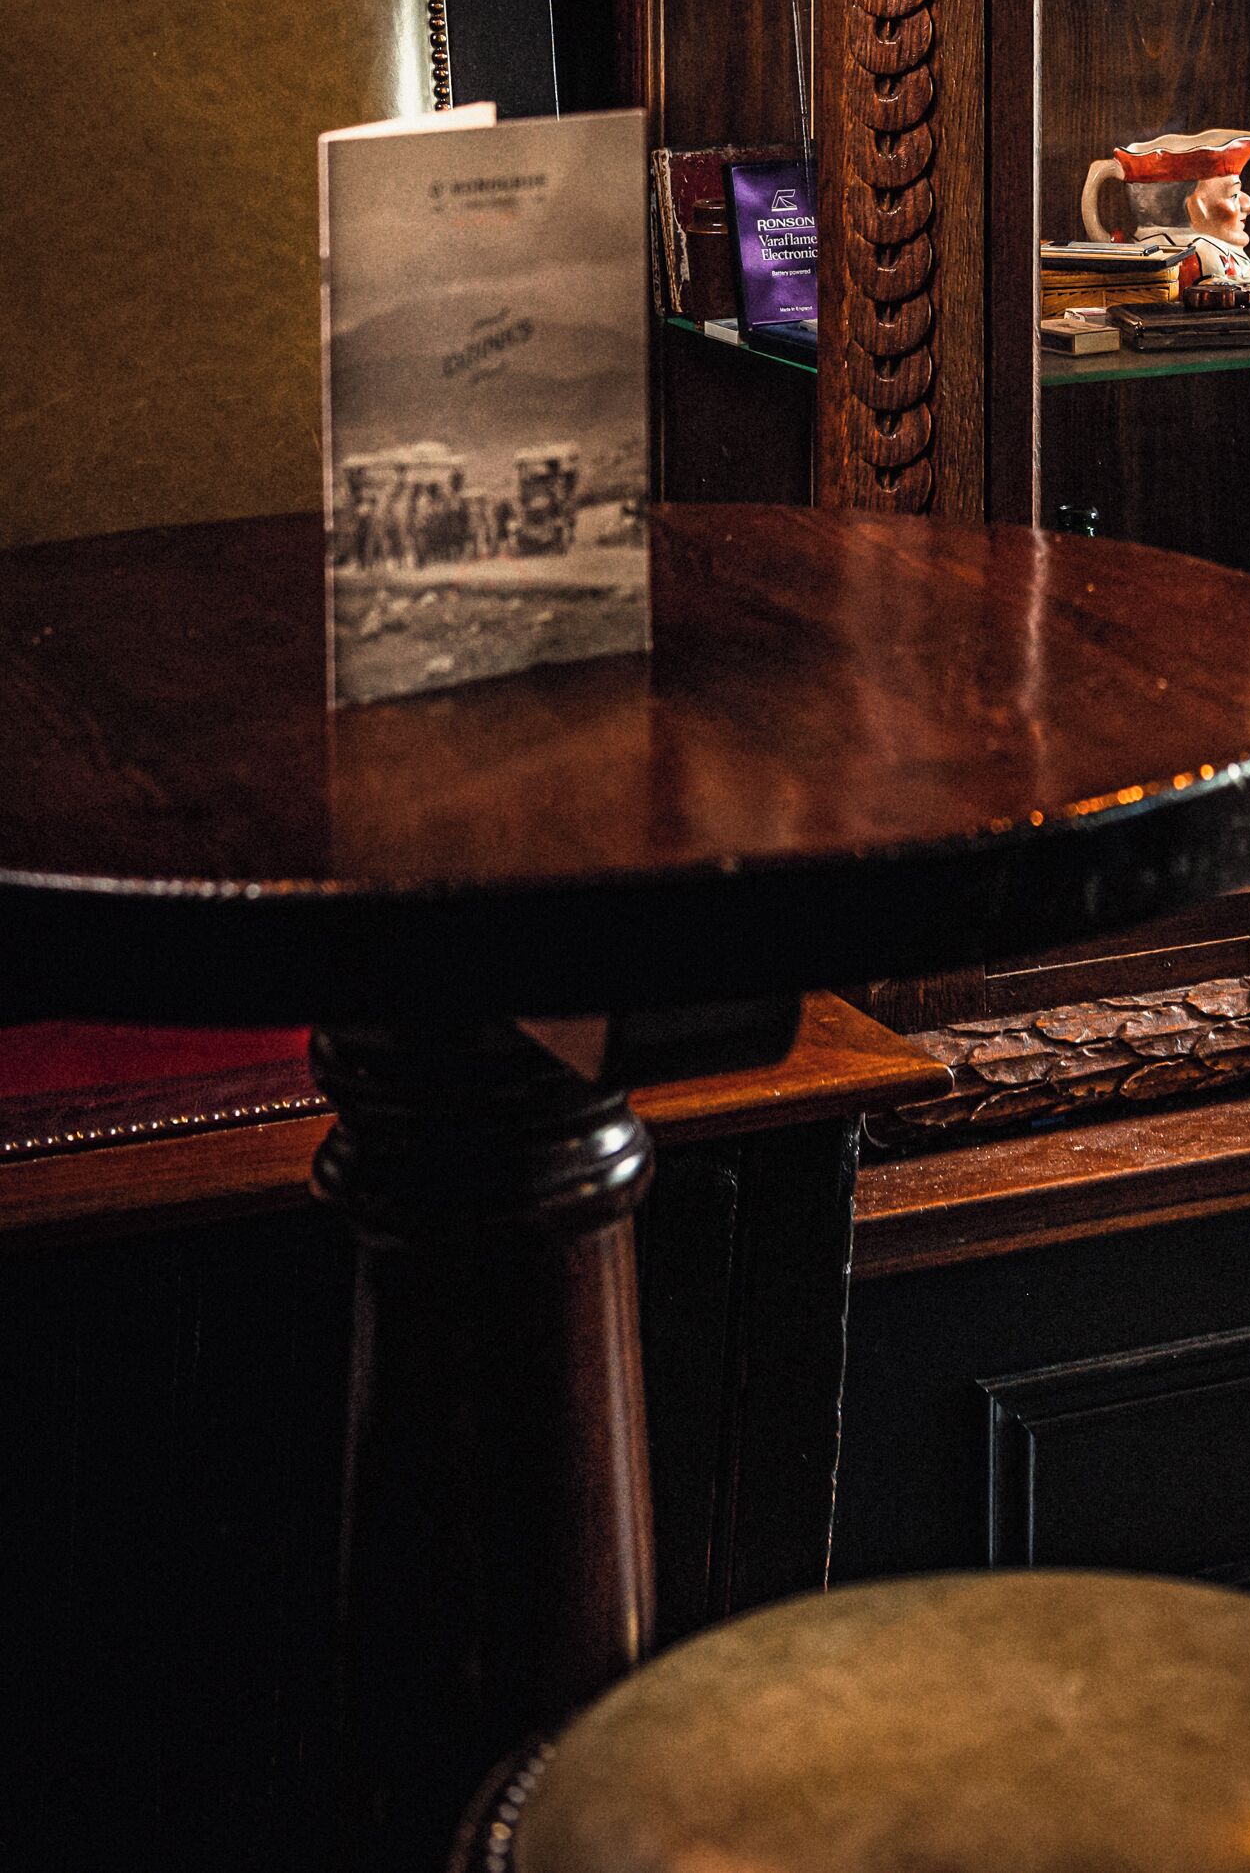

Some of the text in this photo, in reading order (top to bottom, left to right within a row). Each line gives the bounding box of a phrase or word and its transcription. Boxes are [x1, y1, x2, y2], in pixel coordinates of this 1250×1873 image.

[757, 216, 815, 231] RONSON
[758, 233, 818, 247] Varaflame
[761, 247, 819, 261] Electronic
